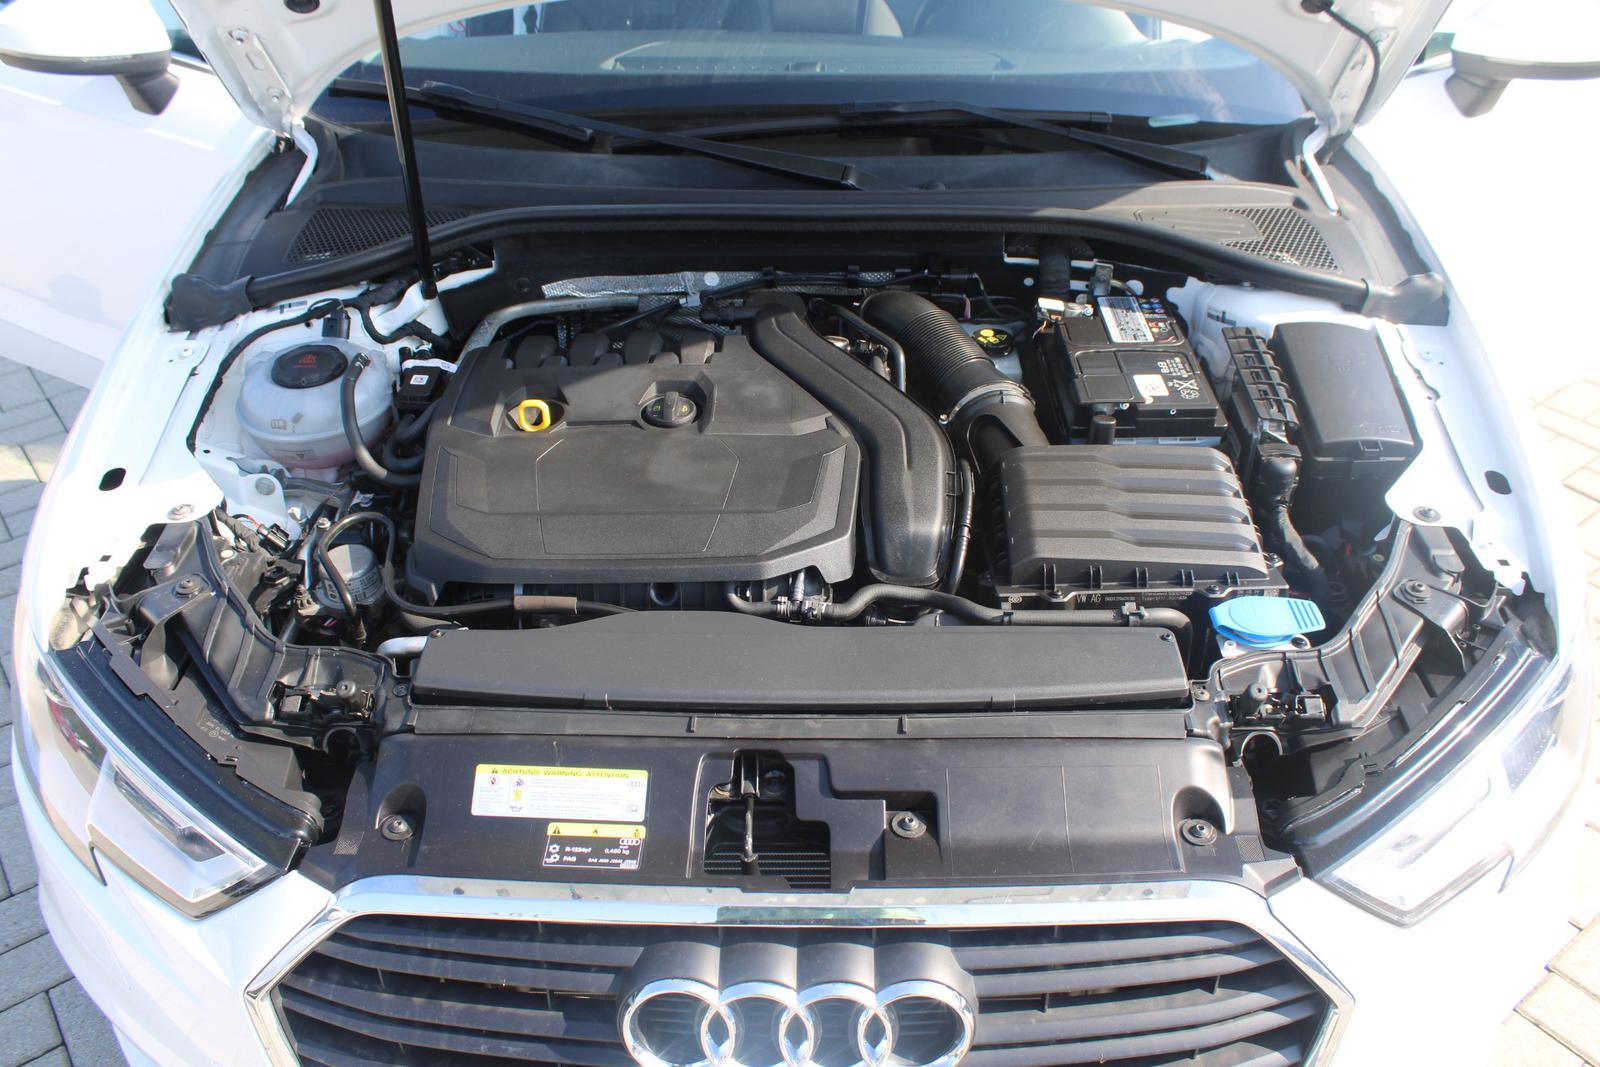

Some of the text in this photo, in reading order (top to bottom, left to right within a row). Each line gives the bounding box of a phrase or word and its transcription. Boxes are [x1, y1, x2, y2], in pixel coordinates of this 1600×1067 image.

[1091, 593, 1101, 603] AG
[502, 768, 539, 776] ACHTUNG
[586, 771, 630, 779] ATTENTION
